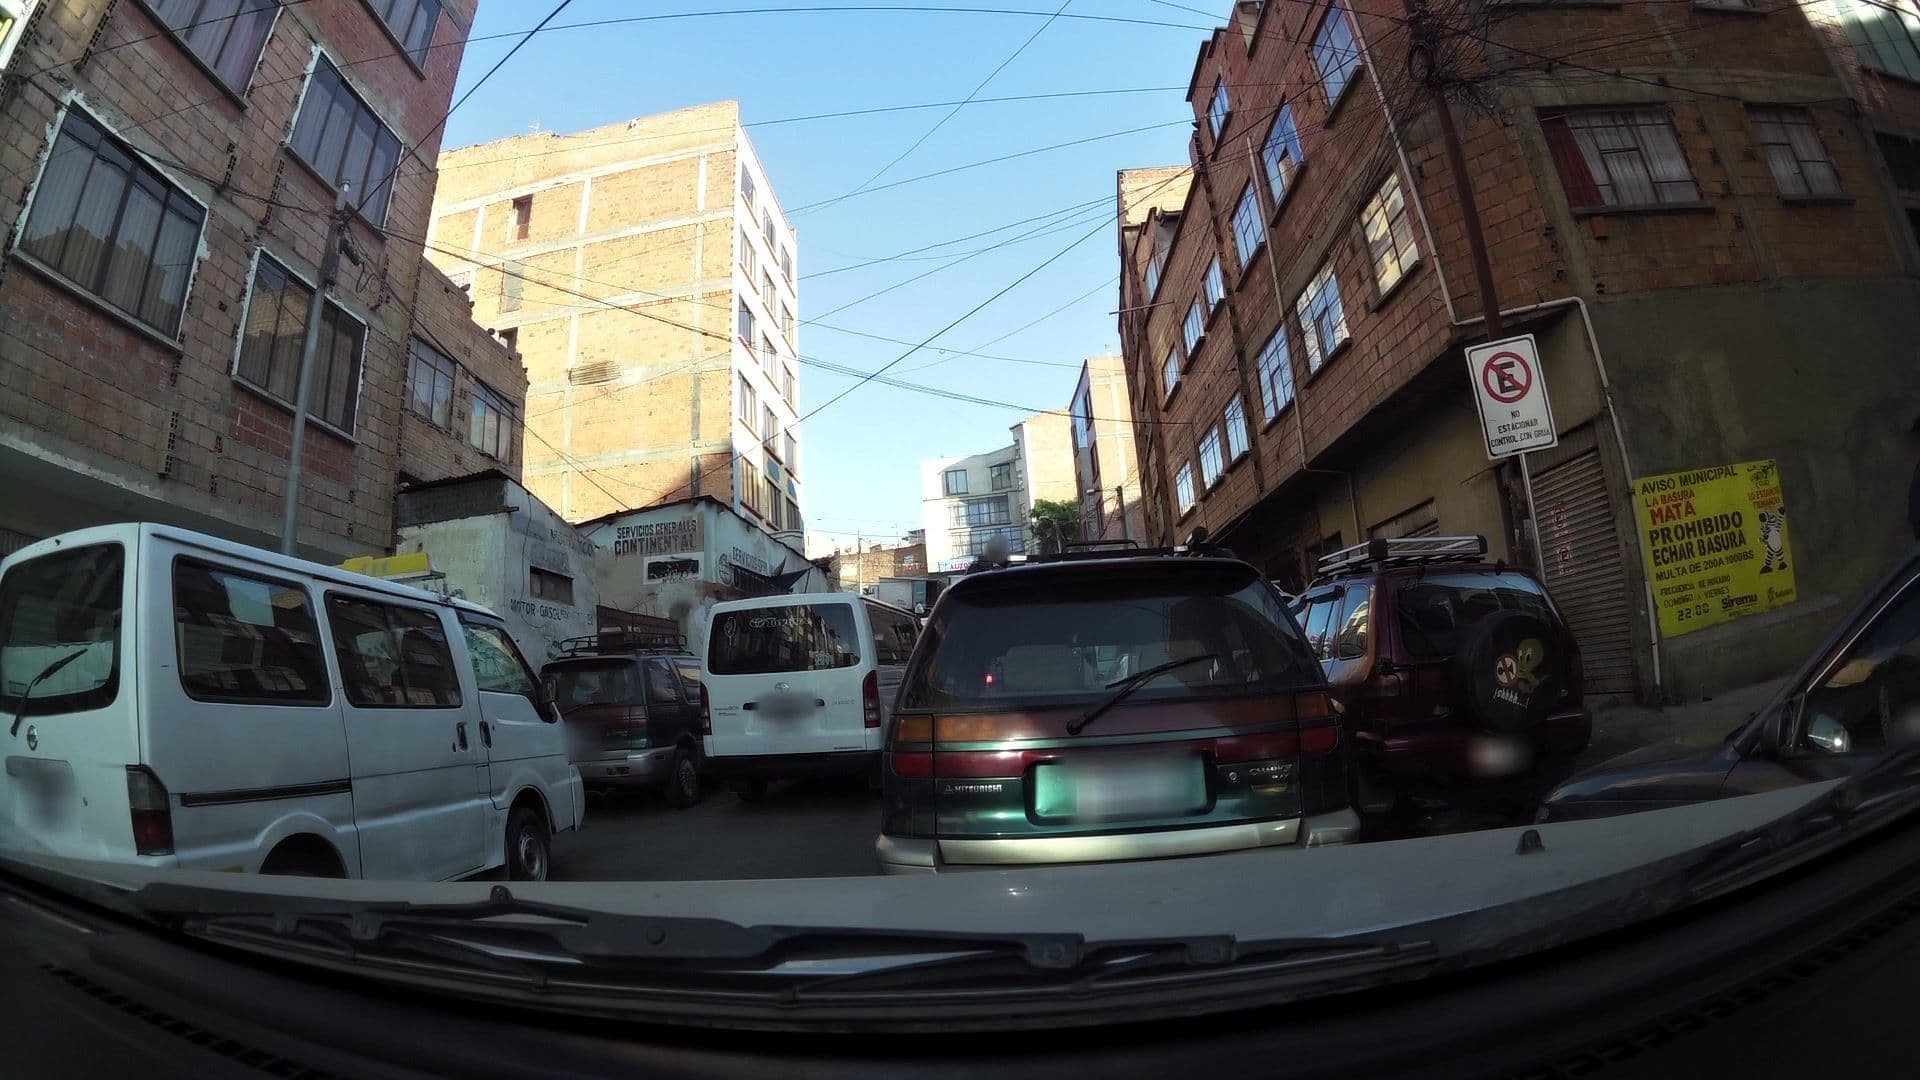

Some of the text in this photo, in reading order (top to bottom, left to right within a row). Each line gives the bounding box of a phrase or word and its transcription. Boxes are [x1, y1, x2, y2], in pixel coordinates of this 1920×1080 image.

[1510, 410, 1520, 419] NO
[1498, 418, 1538, 433] ESTACIONAR
[1490, 435, 1518, 447] CONTROL
[1519, 431, 1532, 442] CON
[1641, 465, 1738, 495] AVISO MUNICIPAL
[1645, 488, 1695, 508] LA BASURA
[1649, 501, 1697, 526] MATA
[617, 519, 697, 539] SERVICIOS GENERALES
[1649, 511, 1743, 547] PROHIBIDO
[614, 533, 697, 556] CONTINENTAL
[1652, 530, 1747, 567] ECHAR BASURA
[1656, 566, 1688, 582] MULTA
[1689, 562, 1702, 573] DE
[1660, 583, 1695, 597] FRECUENCIA
[1663, 595, 1694, 609] DOMINGO
[1704, 586, 1730, 599] VIERNES
[510, 598, 536, 616] MOTOR
[954, 783, 1003, 793] MITSUBISHI
